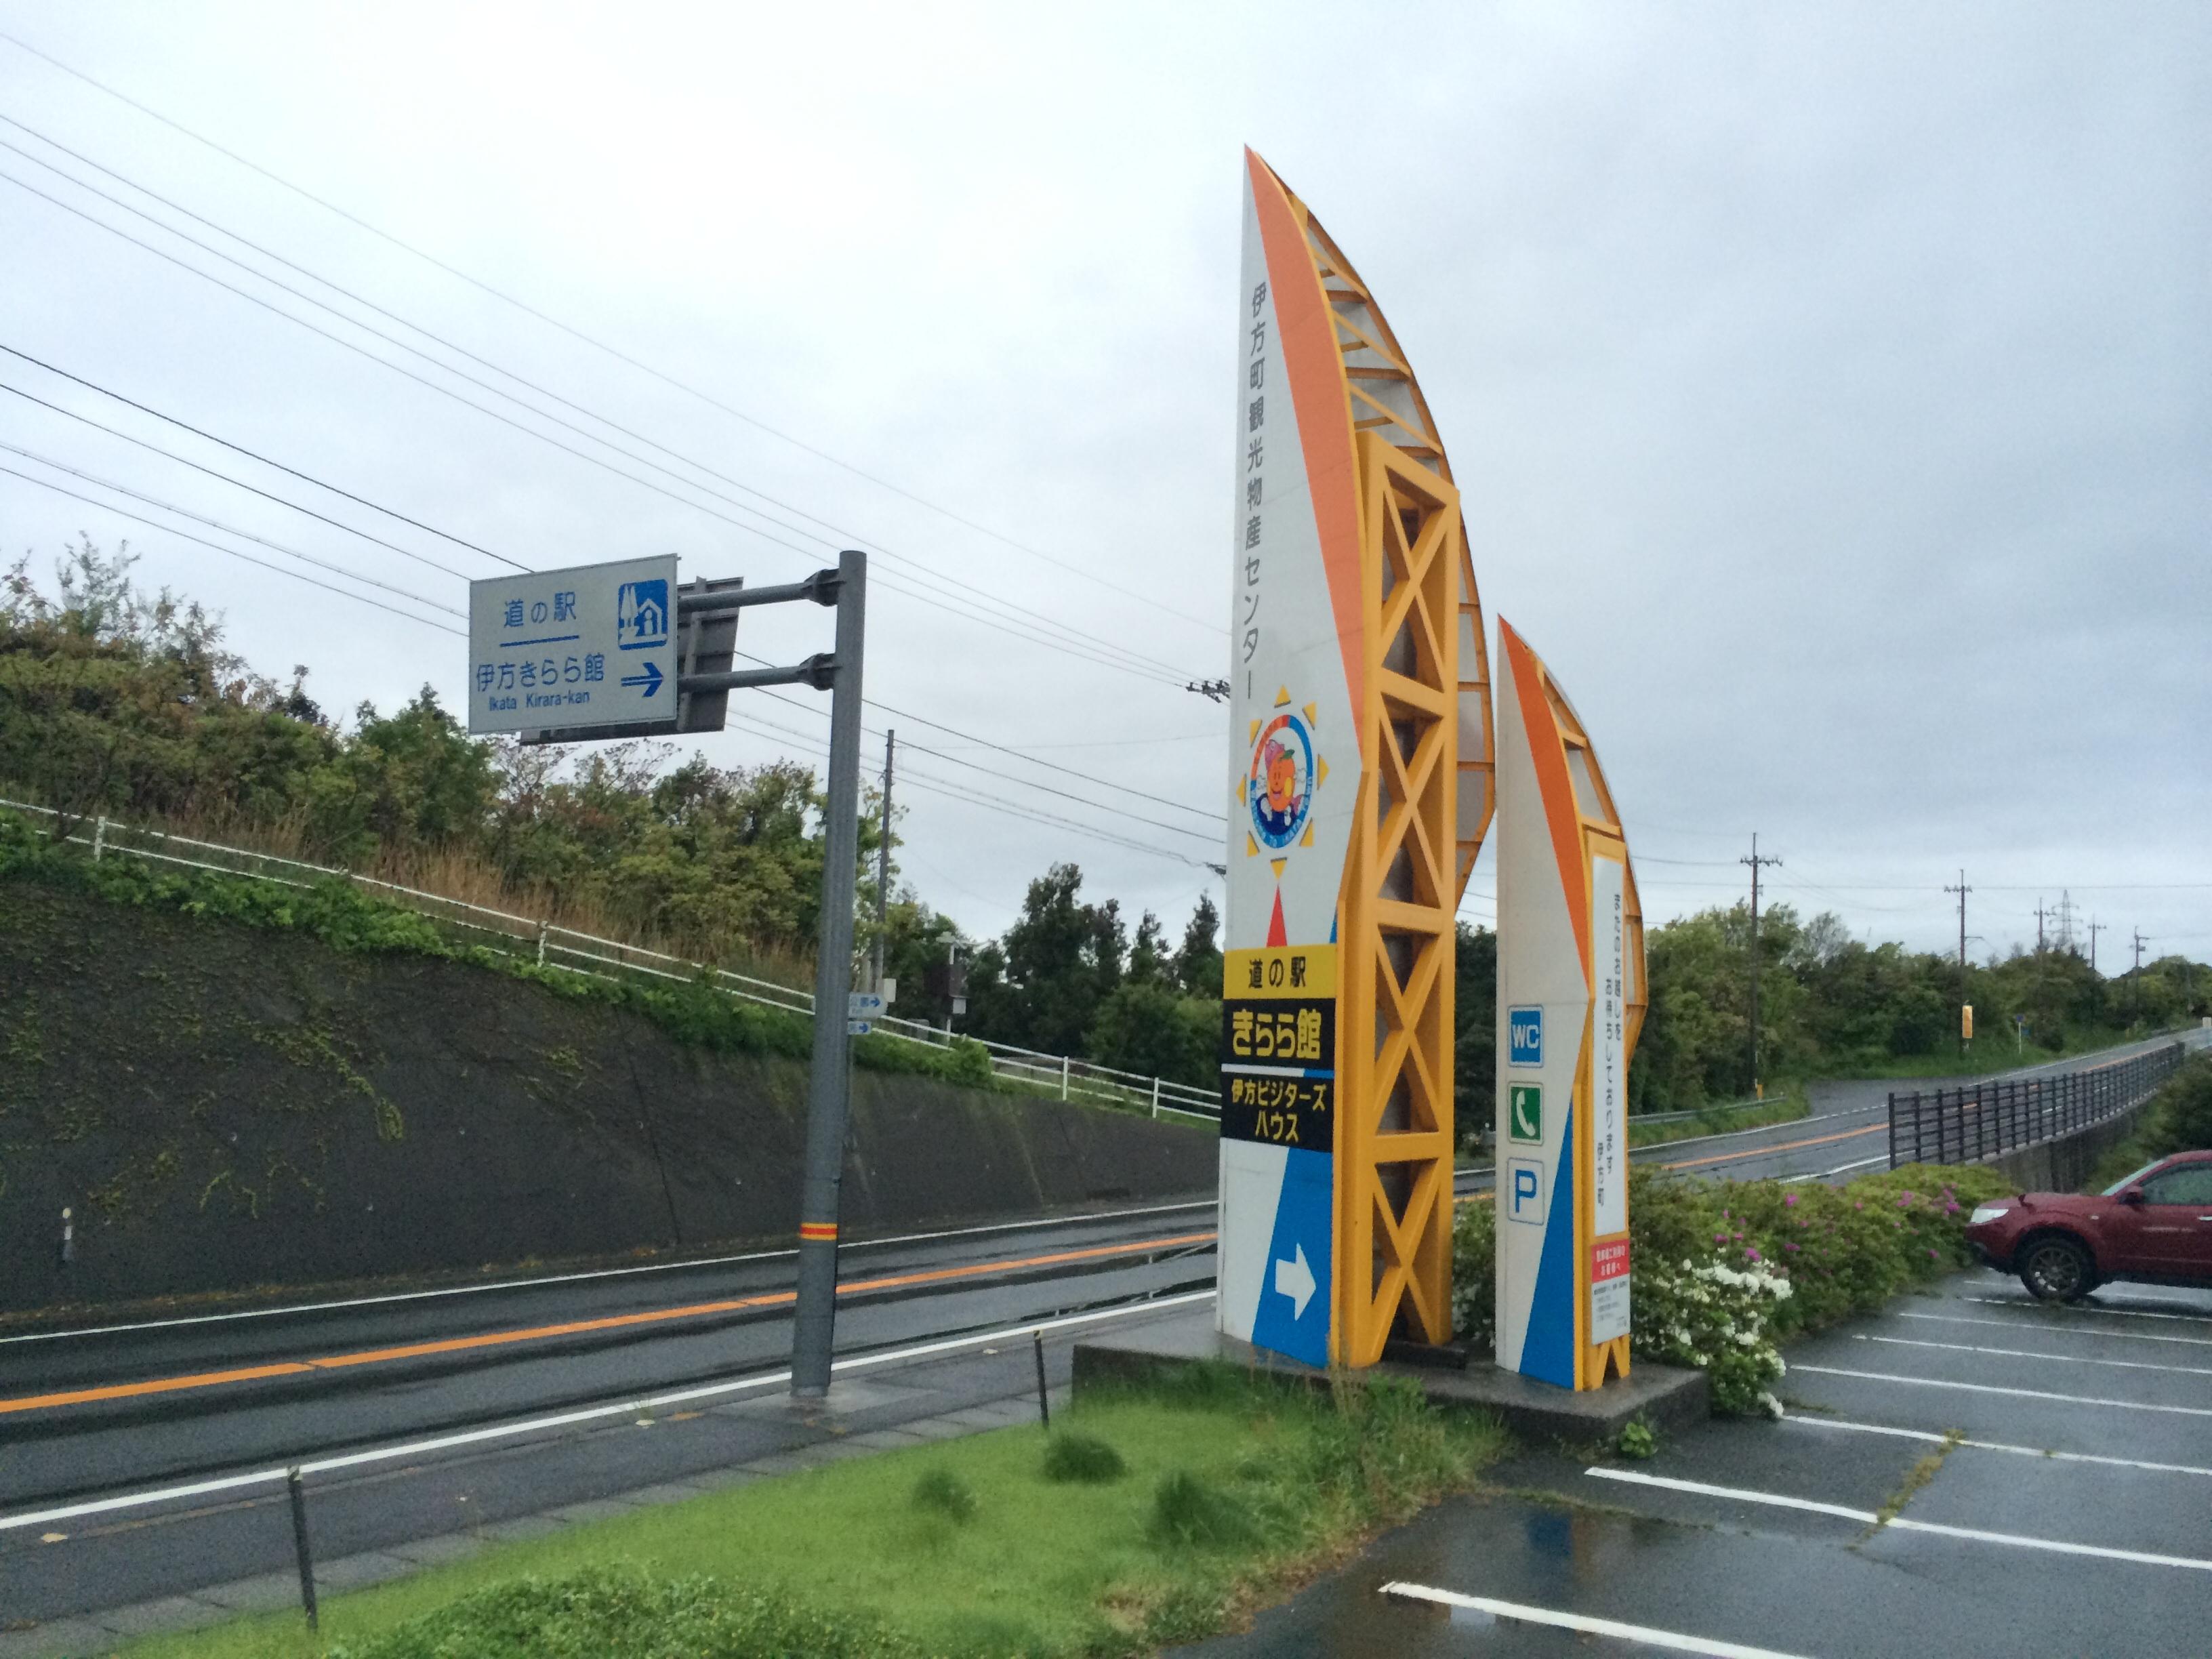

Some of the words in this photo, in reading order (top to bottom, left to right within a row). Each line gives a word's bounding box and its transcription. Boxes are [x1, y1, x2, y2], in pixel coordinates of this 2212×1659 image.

[1243, 282, 1267, 699] 伊方町観光物産センター
[504, 592, 576, 628] 道の駅
[476, 653, 605, 692] 伊方きらら館
[489, 695, 517, 712] Ikata
[526, 690, 590, 706] Kirara-kan
[1248, 956, 1306, 989] 道の駅
[1232, 1008, 1322, 1060] きらら館
[1512, 1024, 1540, 1049] WC
[1231, 1079, 1327, 1111] 伊方ビジターズ
[1255, 1110, 1298, 1143] ハウス
[1515, 1169, 1537, 1213] P
